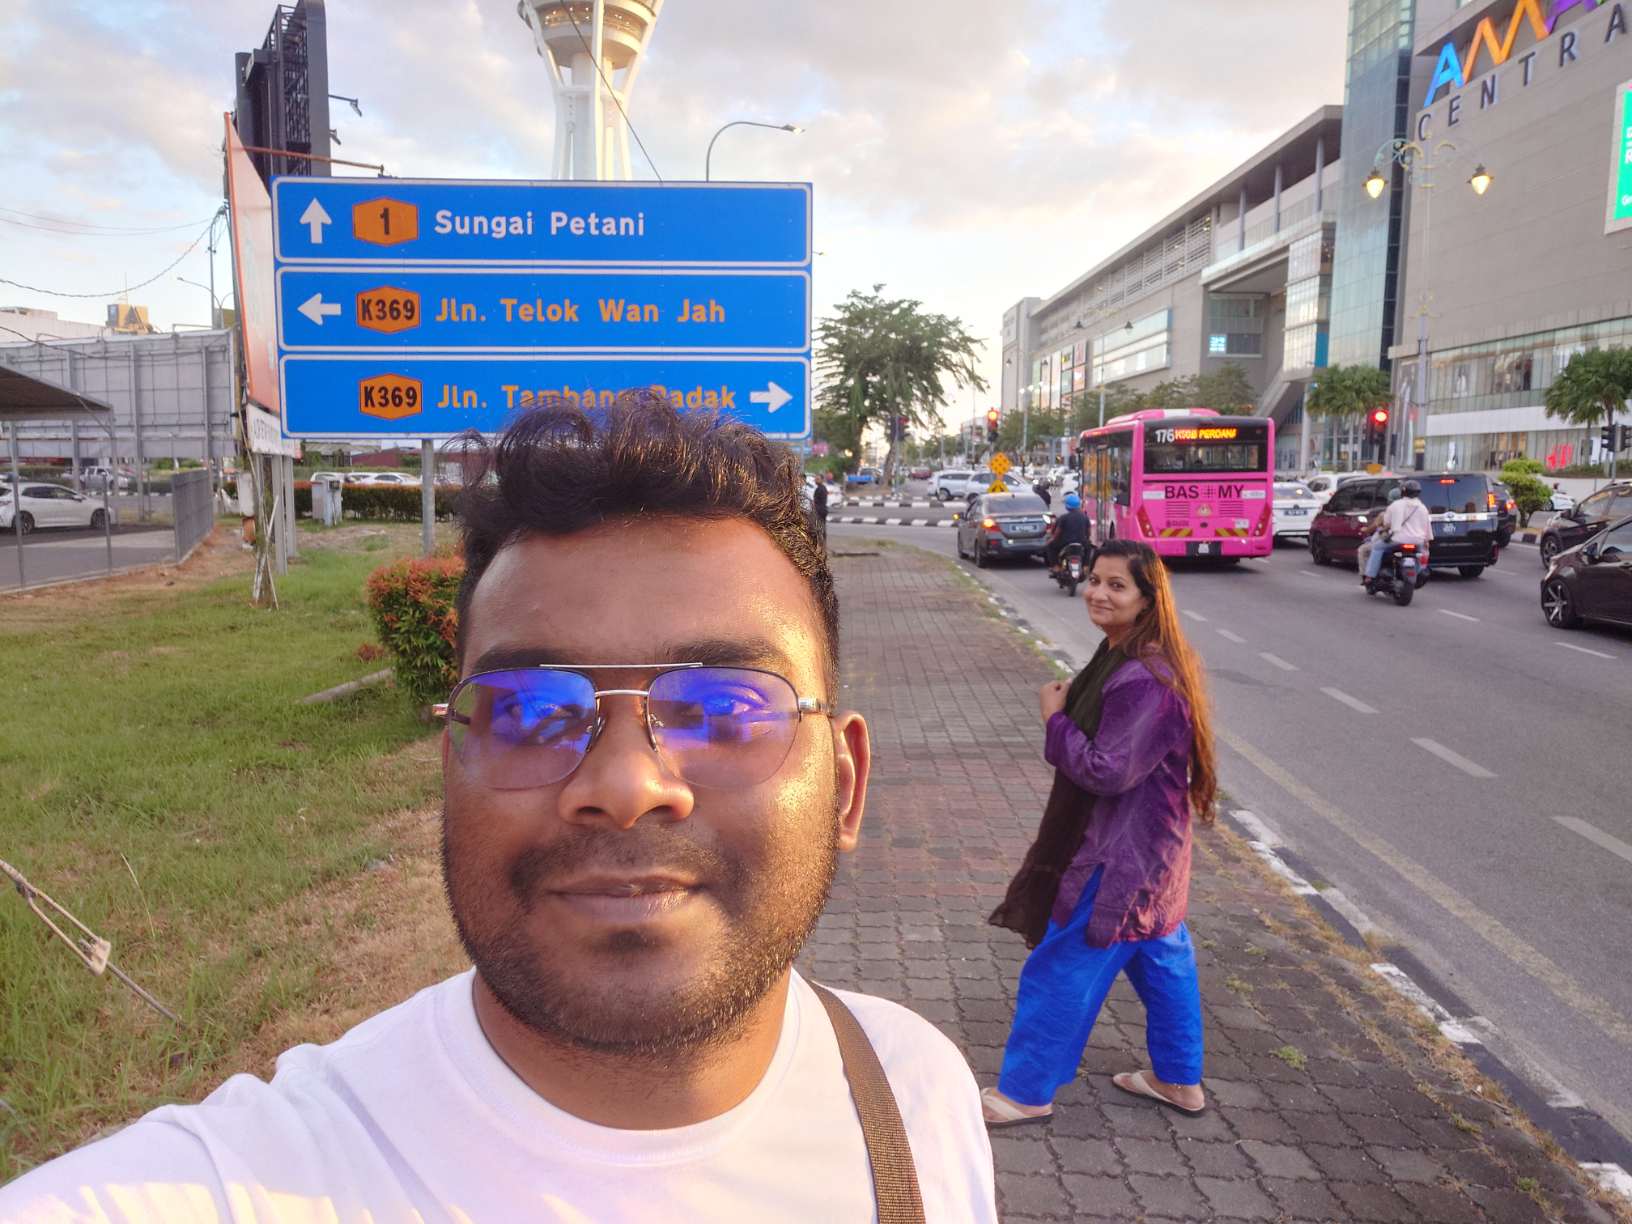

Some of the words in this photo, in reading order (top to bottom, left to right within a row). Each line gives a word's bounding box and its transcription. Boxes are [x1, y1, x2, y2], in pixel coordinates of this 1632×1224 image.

[379, 207, 391, 236] 1
[434, 209, 533, 239] Sungai
[550, 211, 646, 237] Petani
[361, 298, 416, 322] K369
[435, 299, 486, 322] Jln.
[500, 298, 579, 322] Telok
[599, 298, 660, 322] Wan
[677, 298, 726, 323] Jah
[363, 385, 418, 409] K369
[437, 385, 488, 409] Jln.
[501, 384, 630, 409] Tamban
[1155, 428, 1175, 443] 176
[1164, 485, 1199, 499] BAS
[1218, 485, 1244, 499] MY
